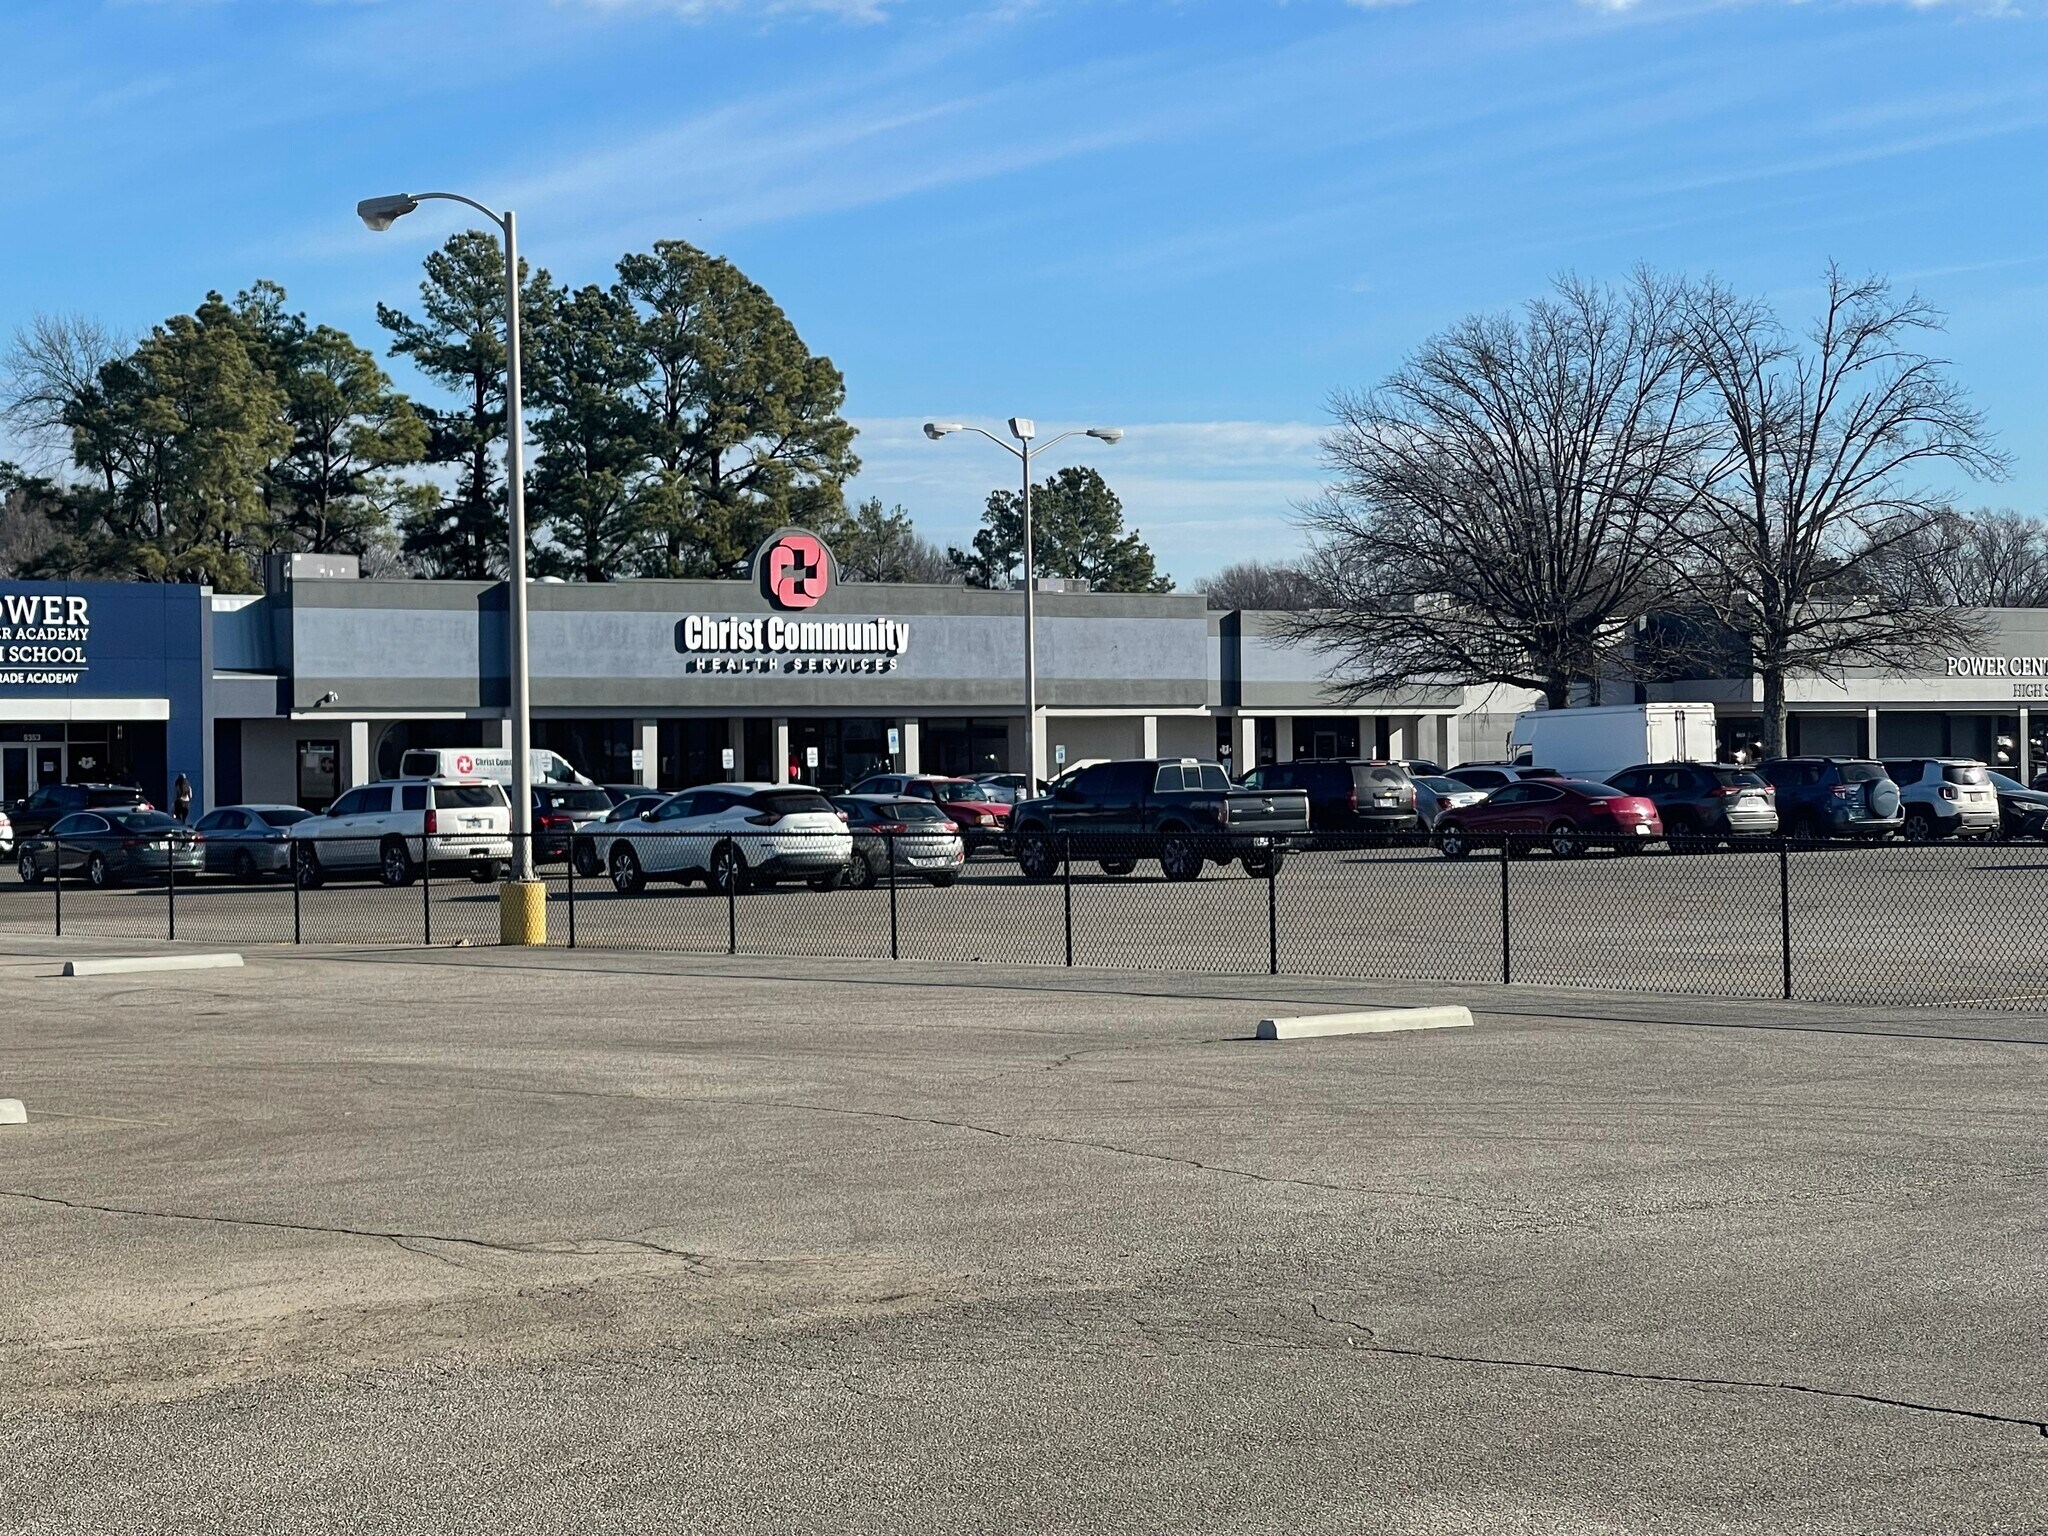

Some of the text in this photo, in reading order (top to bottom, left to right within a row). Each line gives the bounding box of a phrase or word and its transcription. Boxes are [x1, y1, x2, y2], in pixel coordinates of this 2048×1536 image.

[0, 595, 90, 625] WER
[15, 627, 90, 641] ACADEMY
[684, 615, 910, 654] Christ Community
[8, 645, 87, 663] SCHOOL
[696, 657, 898, 670] HEALTH SERVICES
[1946, 656, 2007, 676] POWER
[26, 673, 79, 684] ACADEMY
[2013, 683, 2043, 697] HIGH
